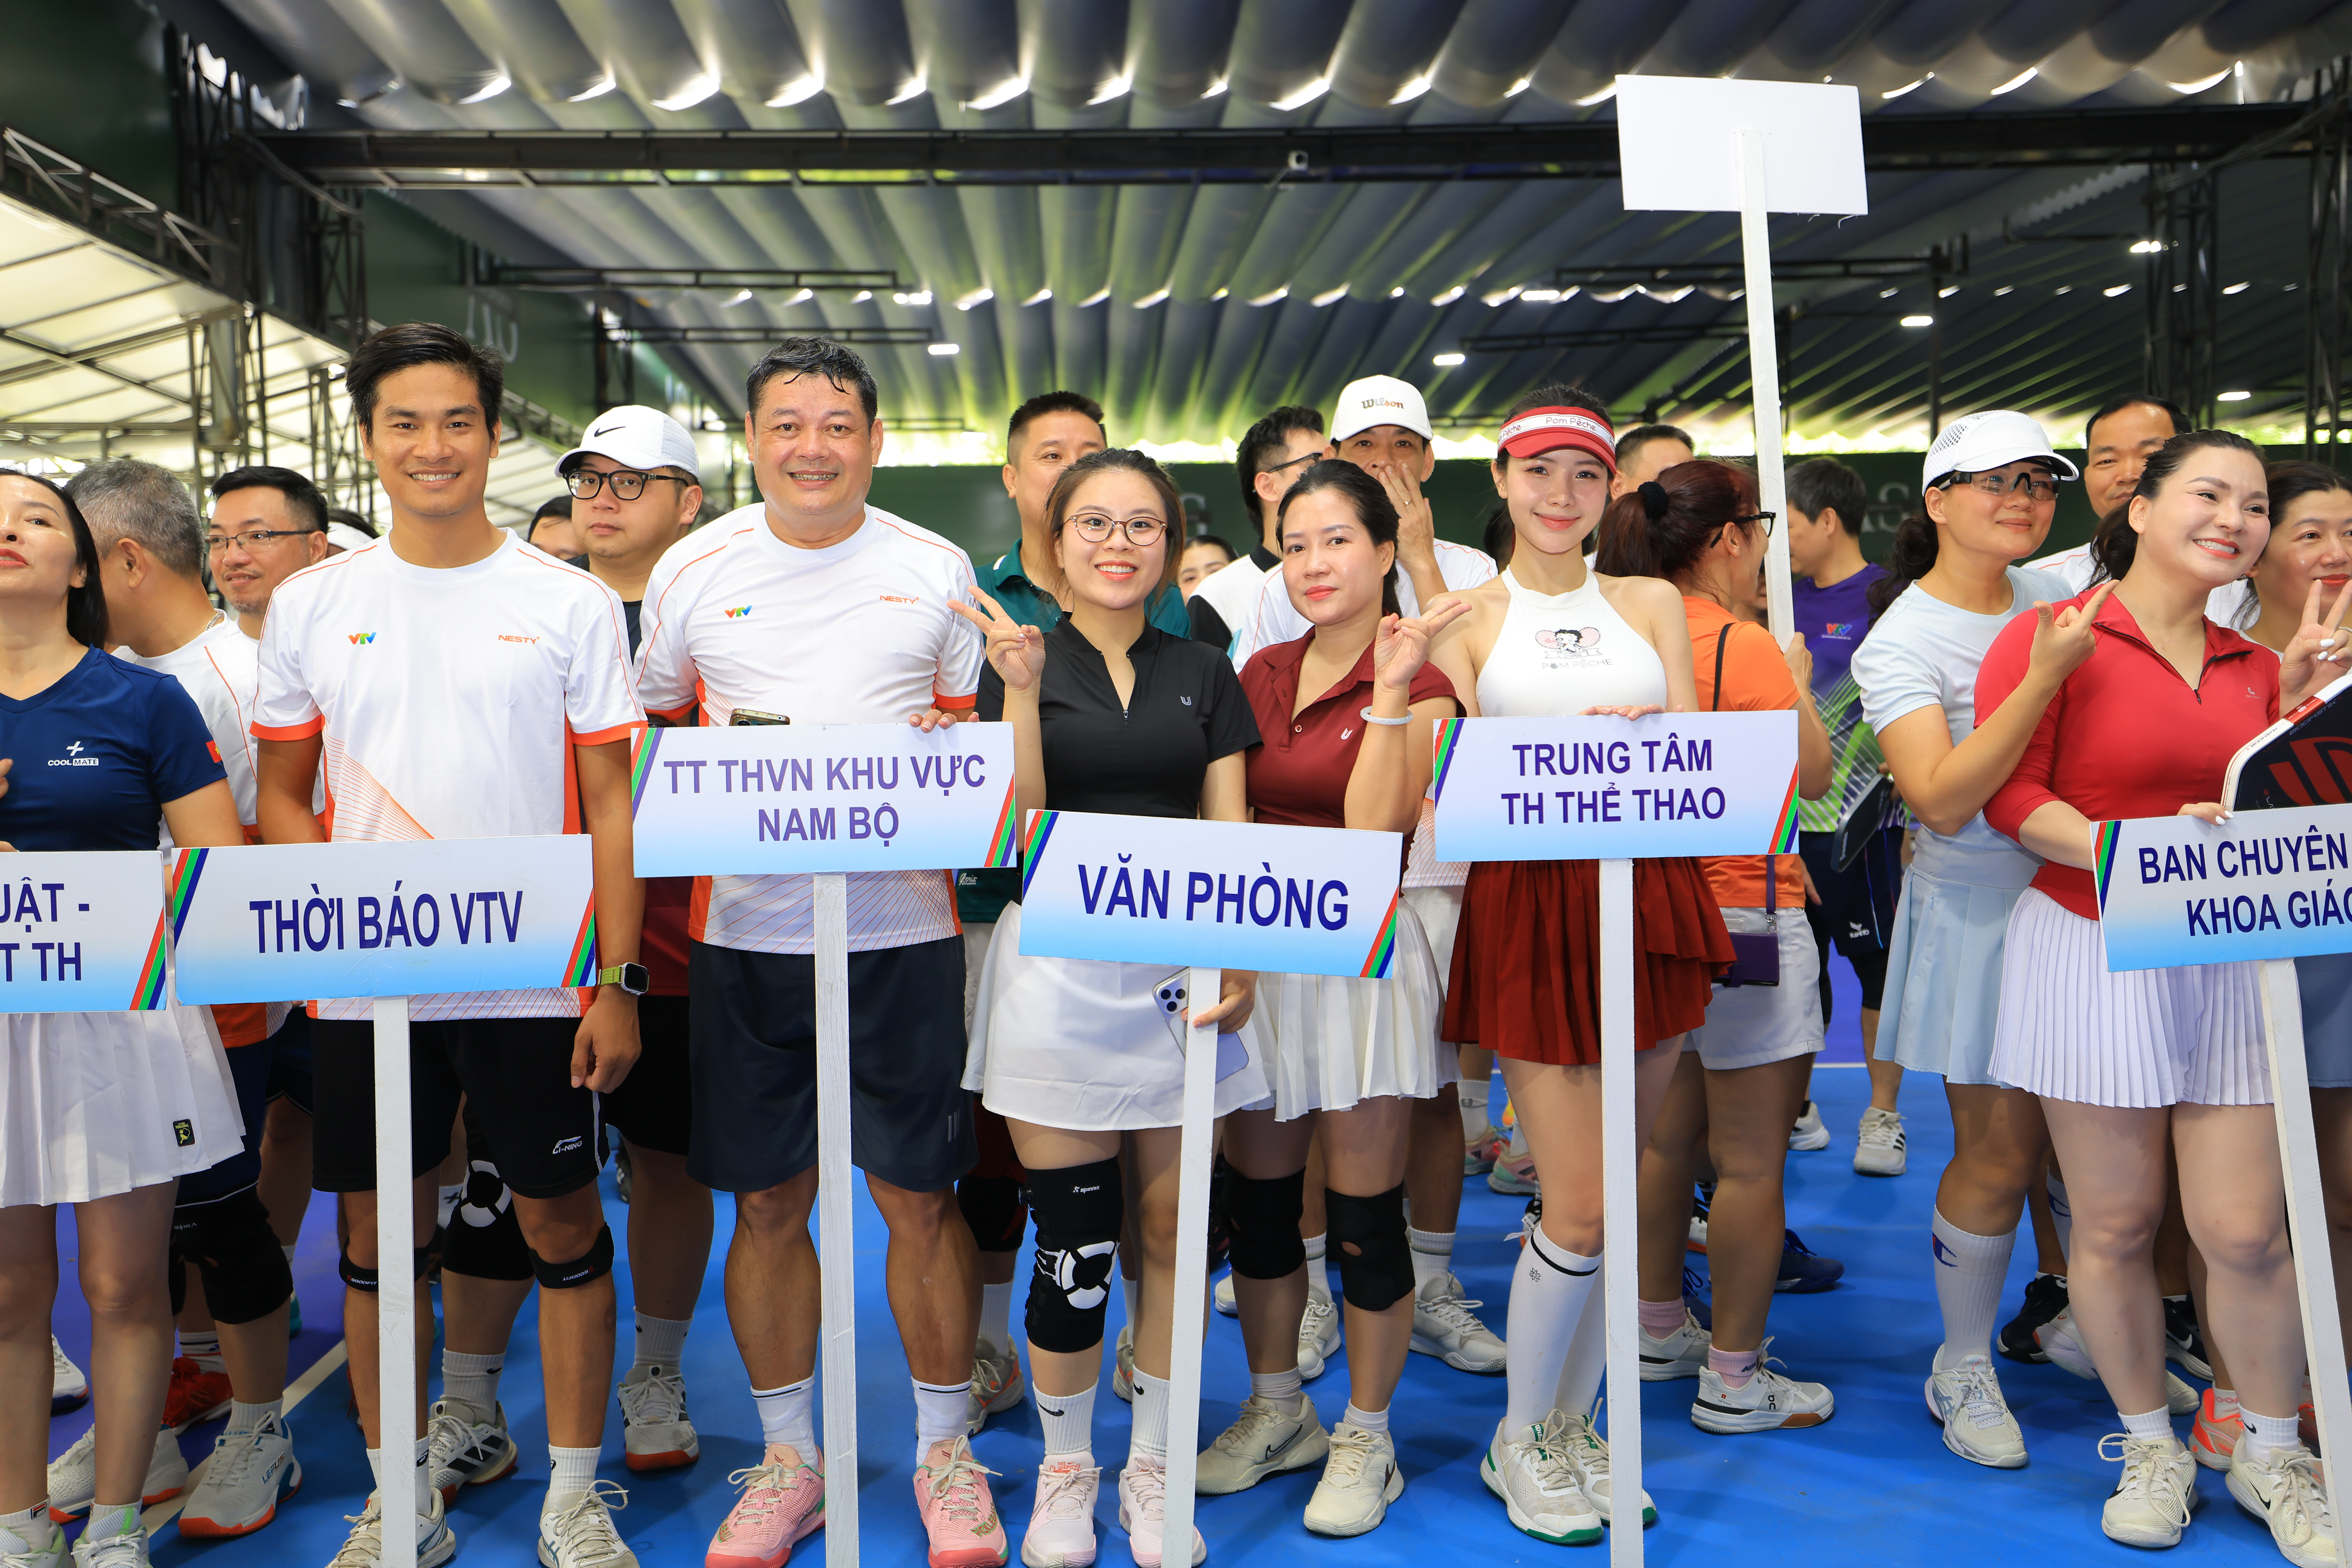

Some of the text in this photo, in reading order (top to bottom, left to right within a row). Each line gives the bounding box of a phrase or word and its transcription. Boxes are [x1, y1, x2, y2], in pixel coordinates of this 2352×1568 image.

[1361, 397, 1405, 409] Wilson
[1546, 416, 1596, 432] Pom Pêche
[724, 605, 753, 618] VTV
[1827, 623, 1852, 636] VTV
[348, 632, 377, 645] VTV
[1513, 732, 1712, 776] TRUNG TÂM
[664, 755, 985, 796] TT THVN KHU VỰC
[1501, 782, 1725, 825] TH THỂ THAO
[759, 802, 898, 847] NAM BỘ
[2139, 824, 2348, 884] BAN CHUYÊN
[1078, 853, 1348, 931] VĂN PHÒNG
[249, 880, 523, 953] THỜI BÁO VTV
[2187, 894, 2282, 937] KHOA
[32, 942, 82, 982] TH
[563, 1270, 589, 1281] GOODFIT
[261, 1452, 285, 1484] LEFUS
